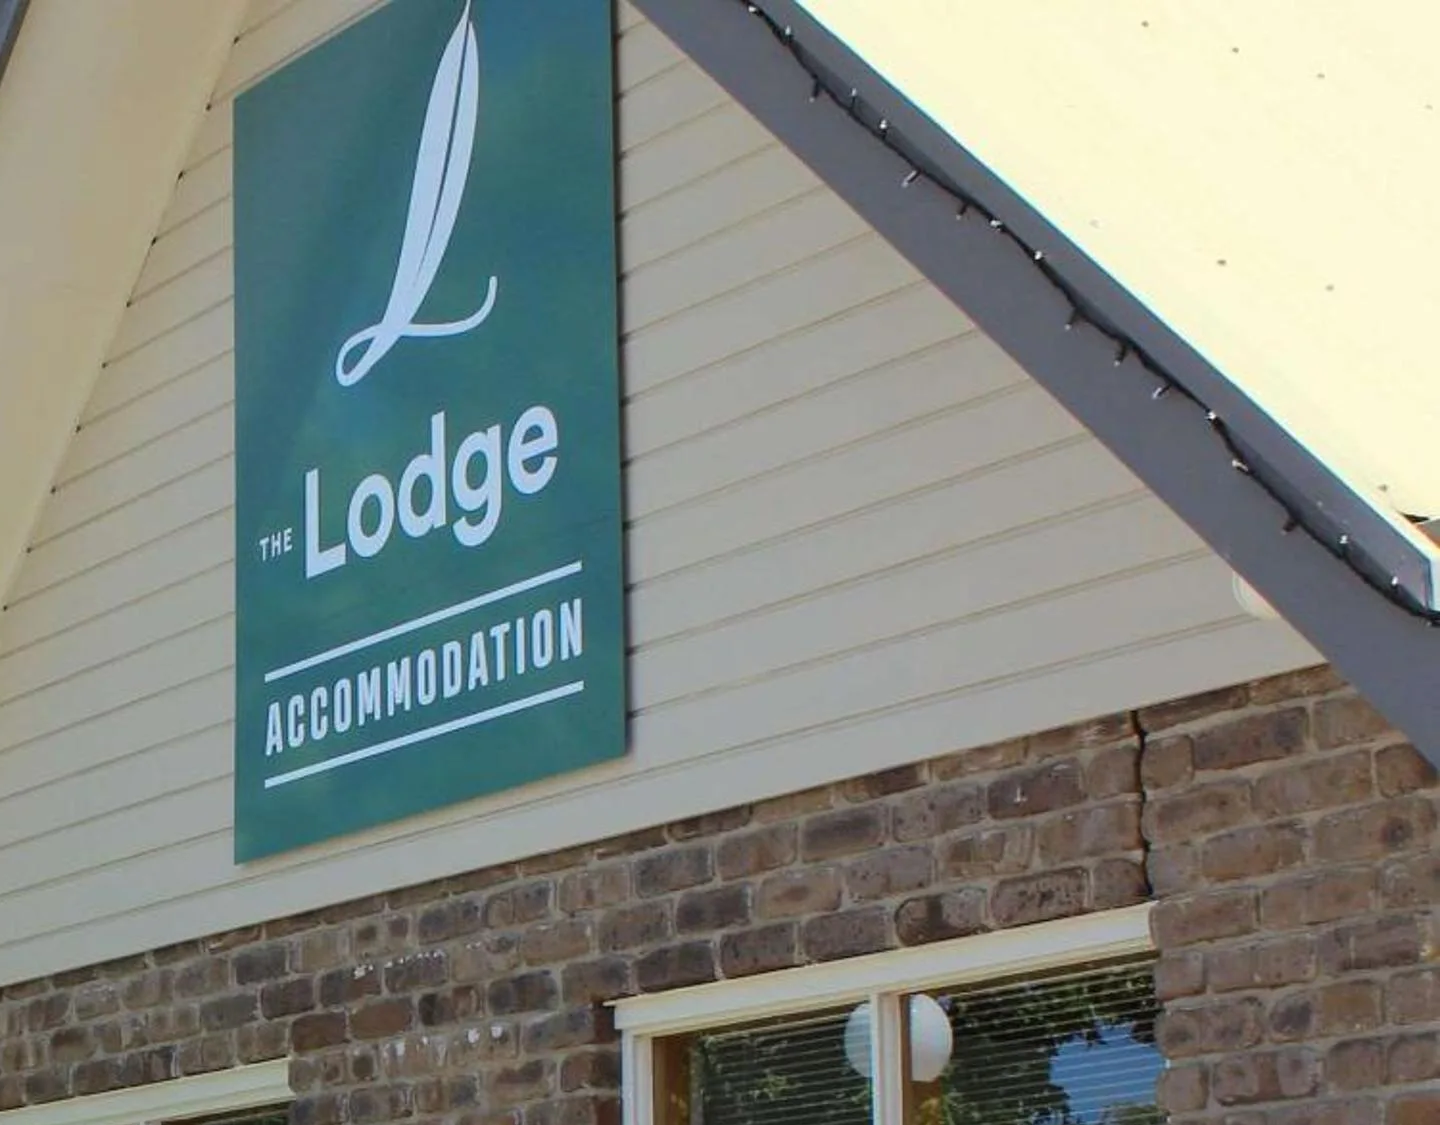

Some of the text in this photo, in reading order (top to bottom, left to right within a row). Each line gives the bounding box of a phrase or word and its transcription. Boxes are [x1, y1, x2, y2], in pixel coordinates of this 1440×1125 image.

[258, 405, 559, 579] THE Lodge
[265, 598, 584, 756] ACCOMMODATION
